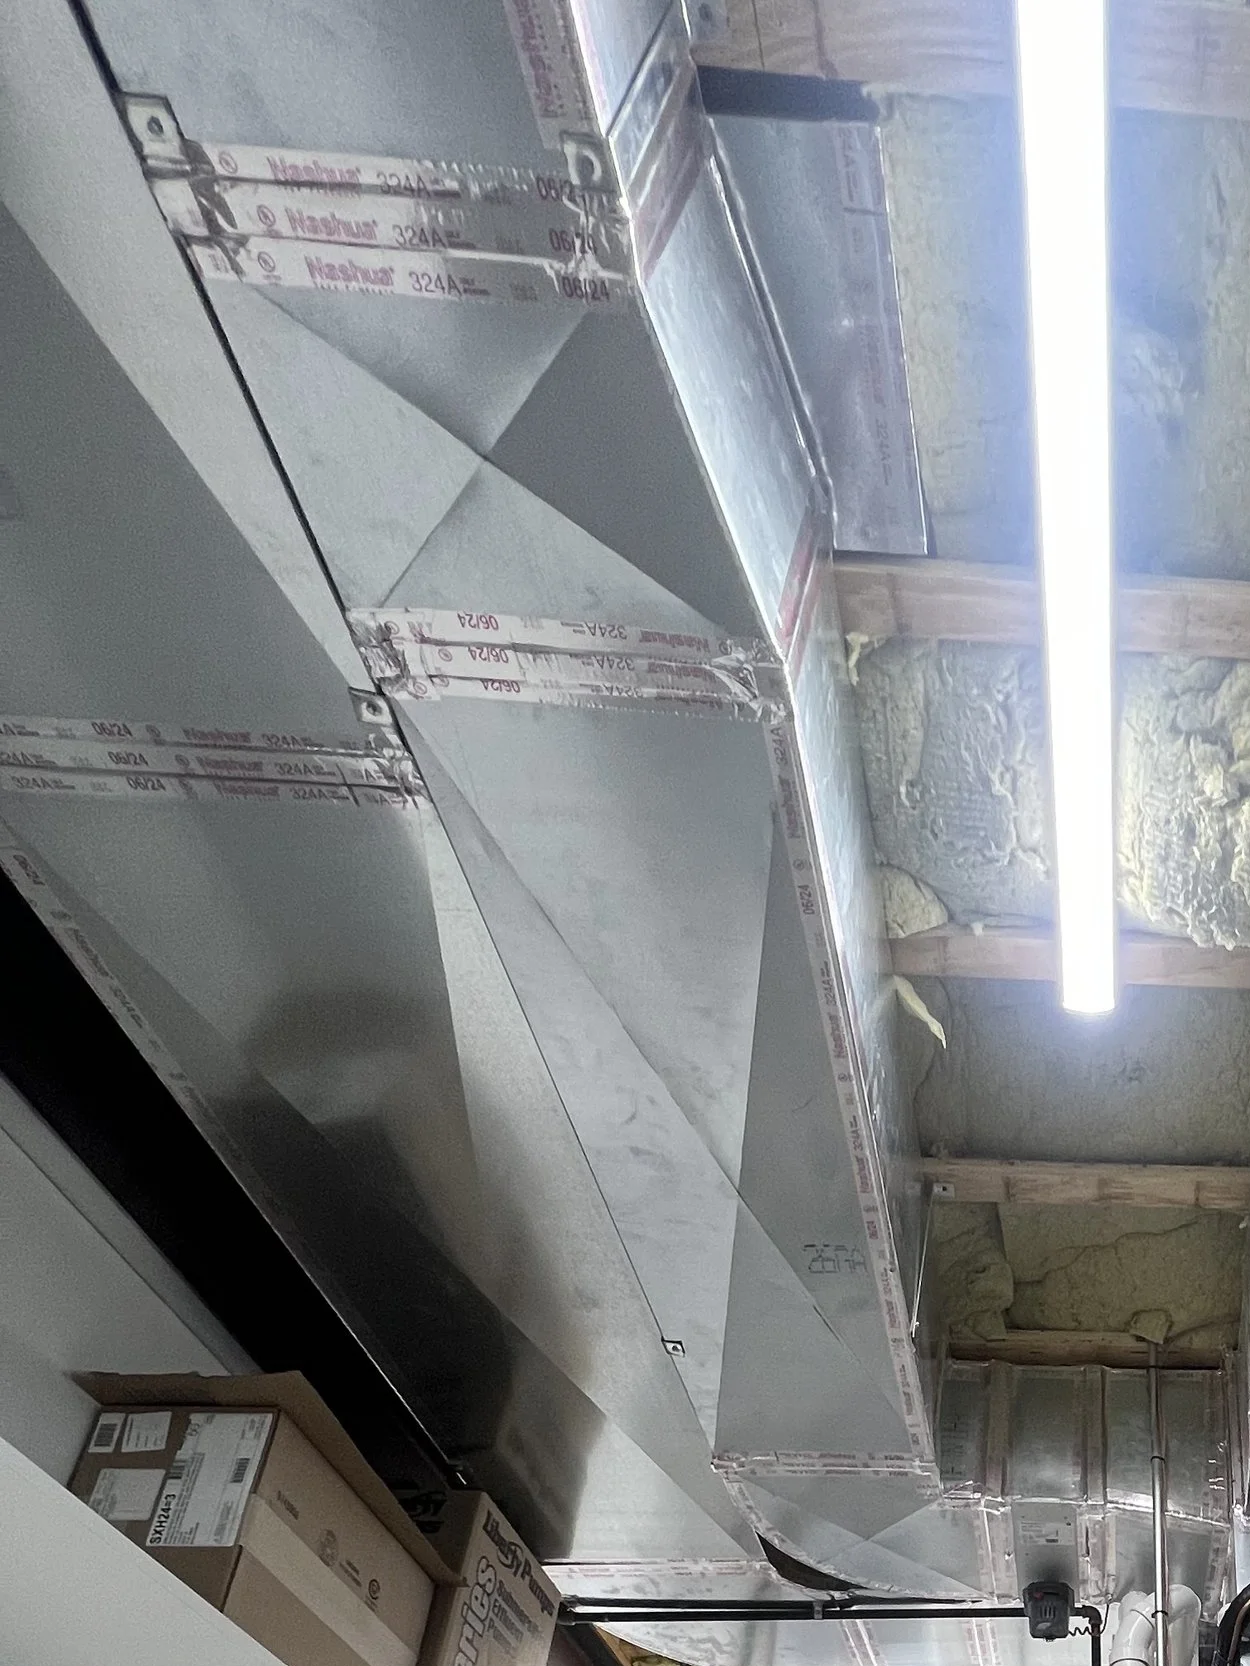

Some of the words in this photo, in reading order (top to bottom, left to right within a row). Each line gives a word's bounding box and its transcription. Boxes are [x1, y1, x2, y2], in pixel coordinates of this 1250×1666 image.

[377, 171, 431, 198] 324A
[536, 175, 574, 200] 06/2
[284, 205, 379, 241] Nashua
[392, 223, 447, 249] 324A
[304, 255, 395, 287] Nashua
[408, 271, 462, 297] 324A
[561, 276, 610, 301] 06/24
[457, 612, 500, 631] 06/24
[584, 621, 628, 640] 324A
[467, 646, 510, 664] 06/24
[593, 654, 637, 672] 324A
[480, 678, 522, 694] 06/24
[91, 721, 134, 738] 06/24
[261, 732, 301, 749] 324A
[107, 751, 150, 767] 06/24
[274, 762, 314, 777] 324A
[11, 774, 51, 789] 324A
[125, 775, 167, 792] 06/24
[797, 884, 815, 916] 06/24
[483, 1509, 522, 1578] Liberty
[519, 1557, 556, 1617] Pumps
